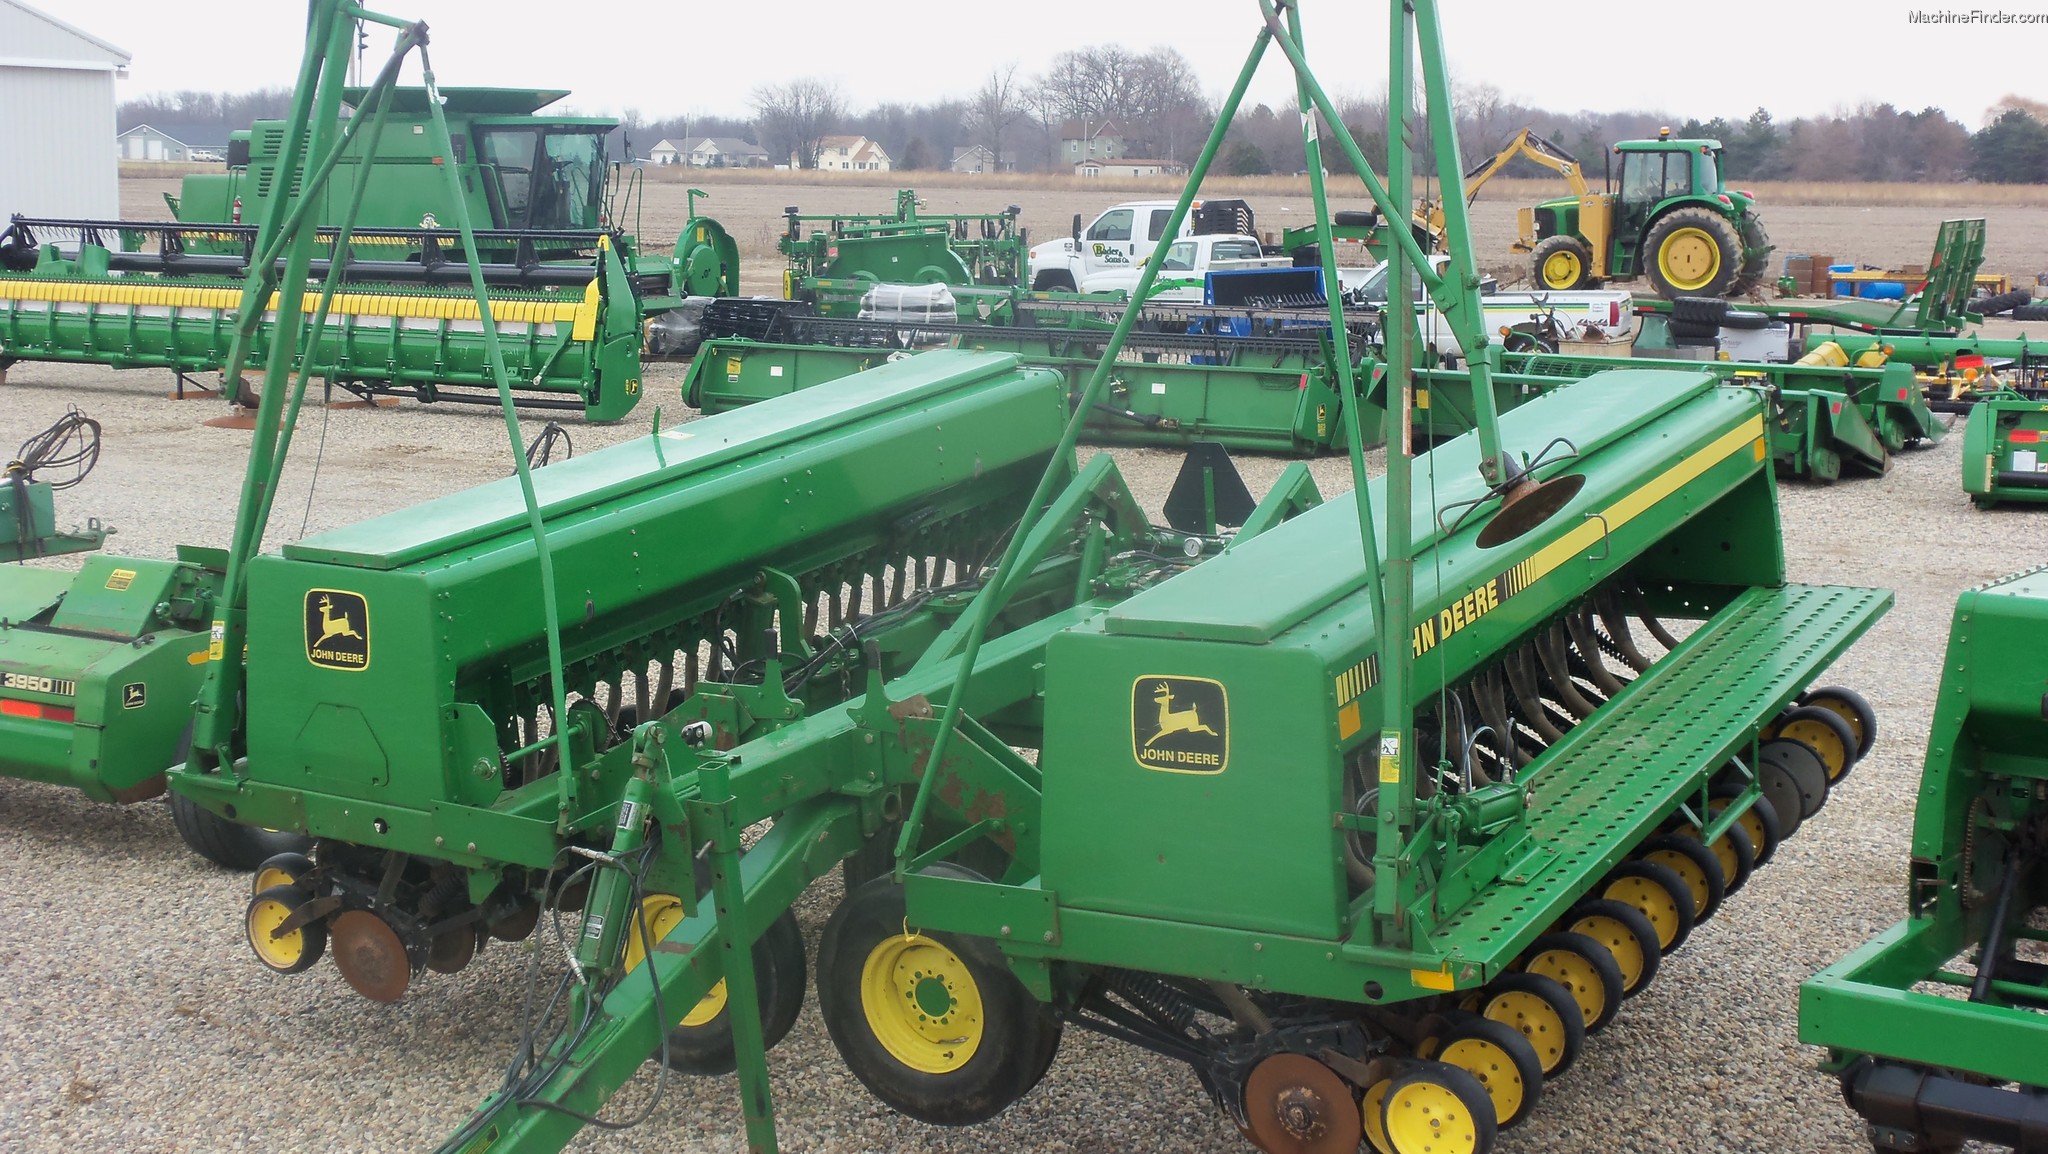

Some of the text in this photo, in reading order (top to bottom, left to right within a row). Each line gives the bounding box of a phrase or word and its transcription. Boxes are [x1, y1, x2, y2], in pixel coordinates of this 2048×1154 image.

[1104, 254, 1121, 263] Sons
[1412, 578, 1499, 660] HN DEERE
[310, 648, 364, 664] JOHN DEERE
[4, 672, 52, 693] 3950
[1140, 748, 1220, 766] JOHN DEERE
